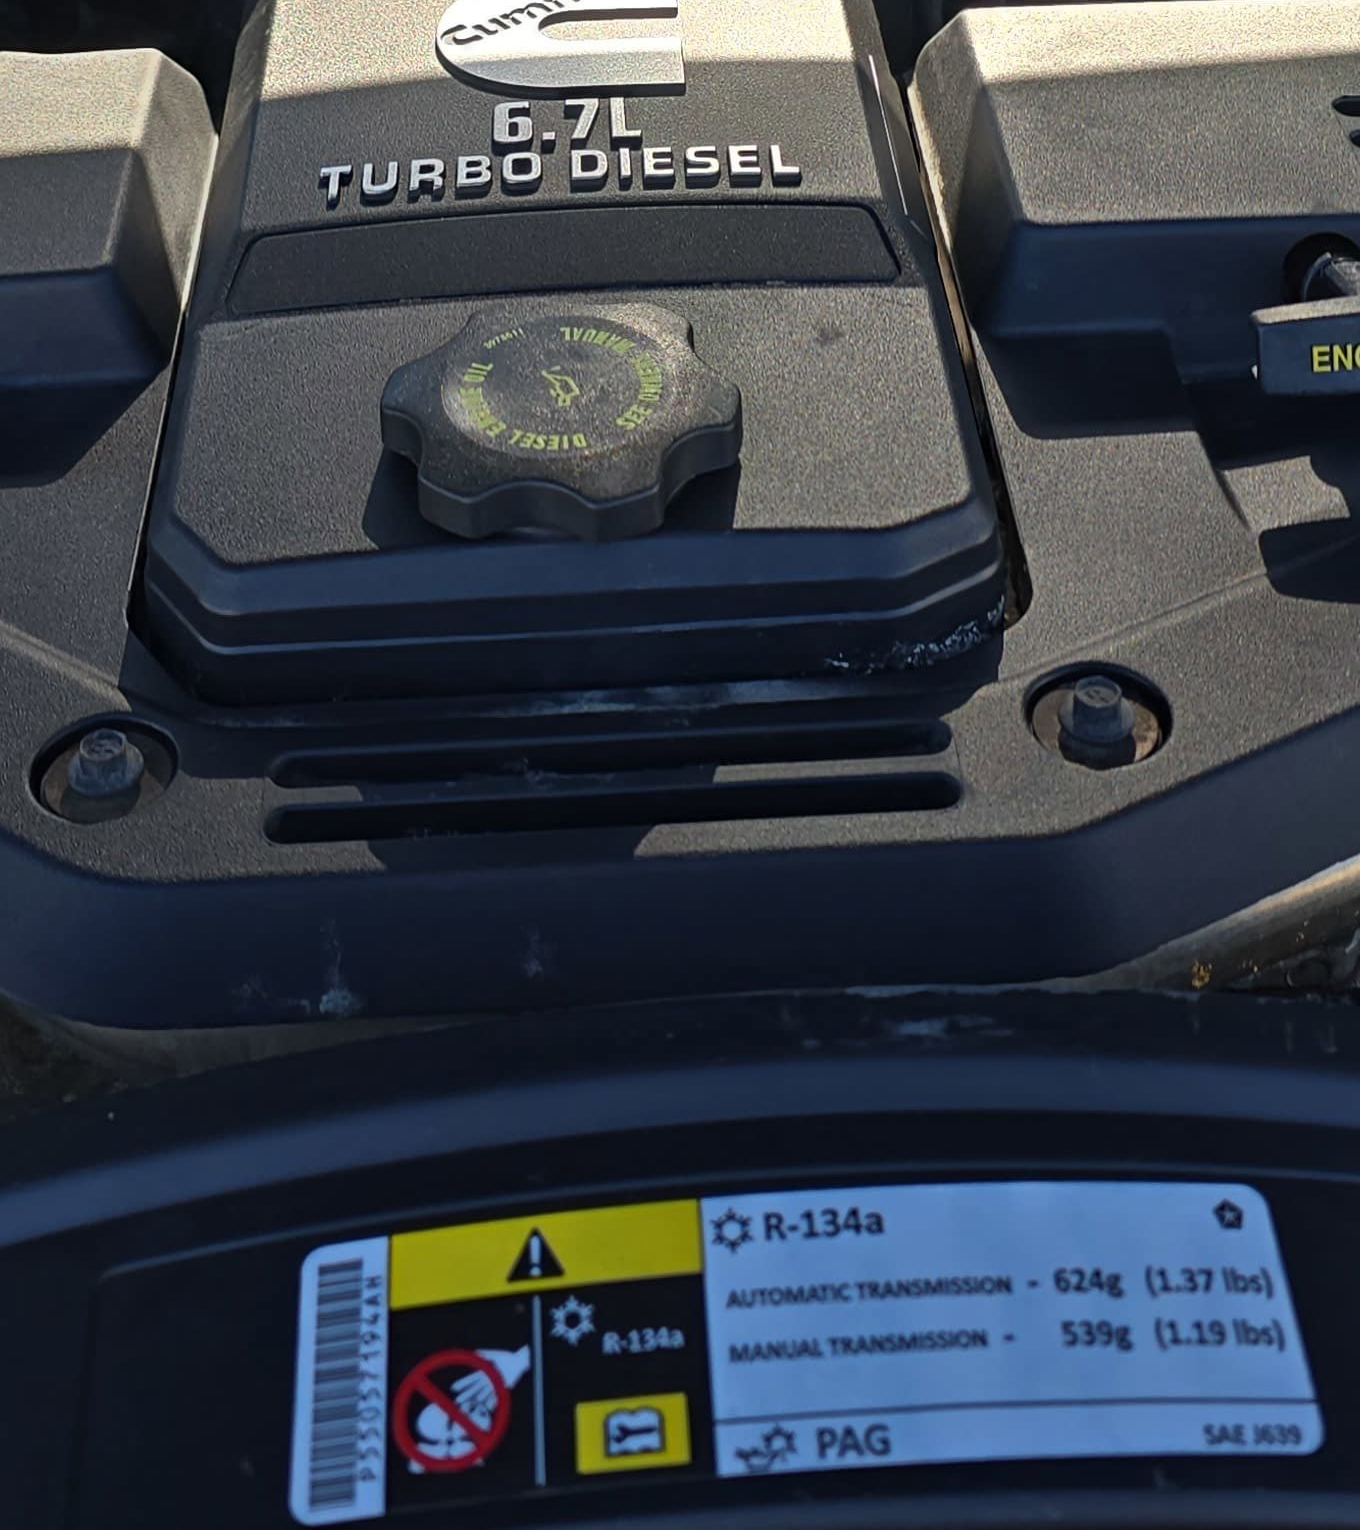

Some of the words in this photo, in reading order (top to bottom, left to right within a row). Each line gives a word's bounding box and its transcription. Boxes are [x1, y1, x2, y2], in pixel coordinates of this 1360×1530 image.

[491, 96, 643, 145] 6.7L
[318, 150, 543, 203] TURBO
[569, 143, 801, 182] DIESEL
[559, 326, 637, 353] MANUAL
[464, 362, 494, 382] OIL
[615, 404, 653, 431] SEE
[508, 428, 588, 451] DIESEL
[762, 1206, 885, 1242] R-134a
[725, 1282, 852, 1309] AUTOMATIC
[854, 1275, 1013, 1301] TRANSMISSION
[1053, 1266, 1125, 1299] 624g
[1144, 1264, 1215, 1299] (1.37
[1222, 1266, 1274, 1300] lbs)
[601, 1326, 686, 1355] R-134a
[727, 1338, 823, 1364] MANUAL
[826, 1328, 989, 1357] TRANSMISSION
[1060, 1319, 1134, 1352] 539g
[1154, 1317, 1227, 1352] (1.19
[1233, 1318, 1286, 1354] lbs)
[815, 1422, 892, 1460] PAG
[1202, 1423, 1247, 1447] SAE
[1251, 1423, 1303, 1447] J639
